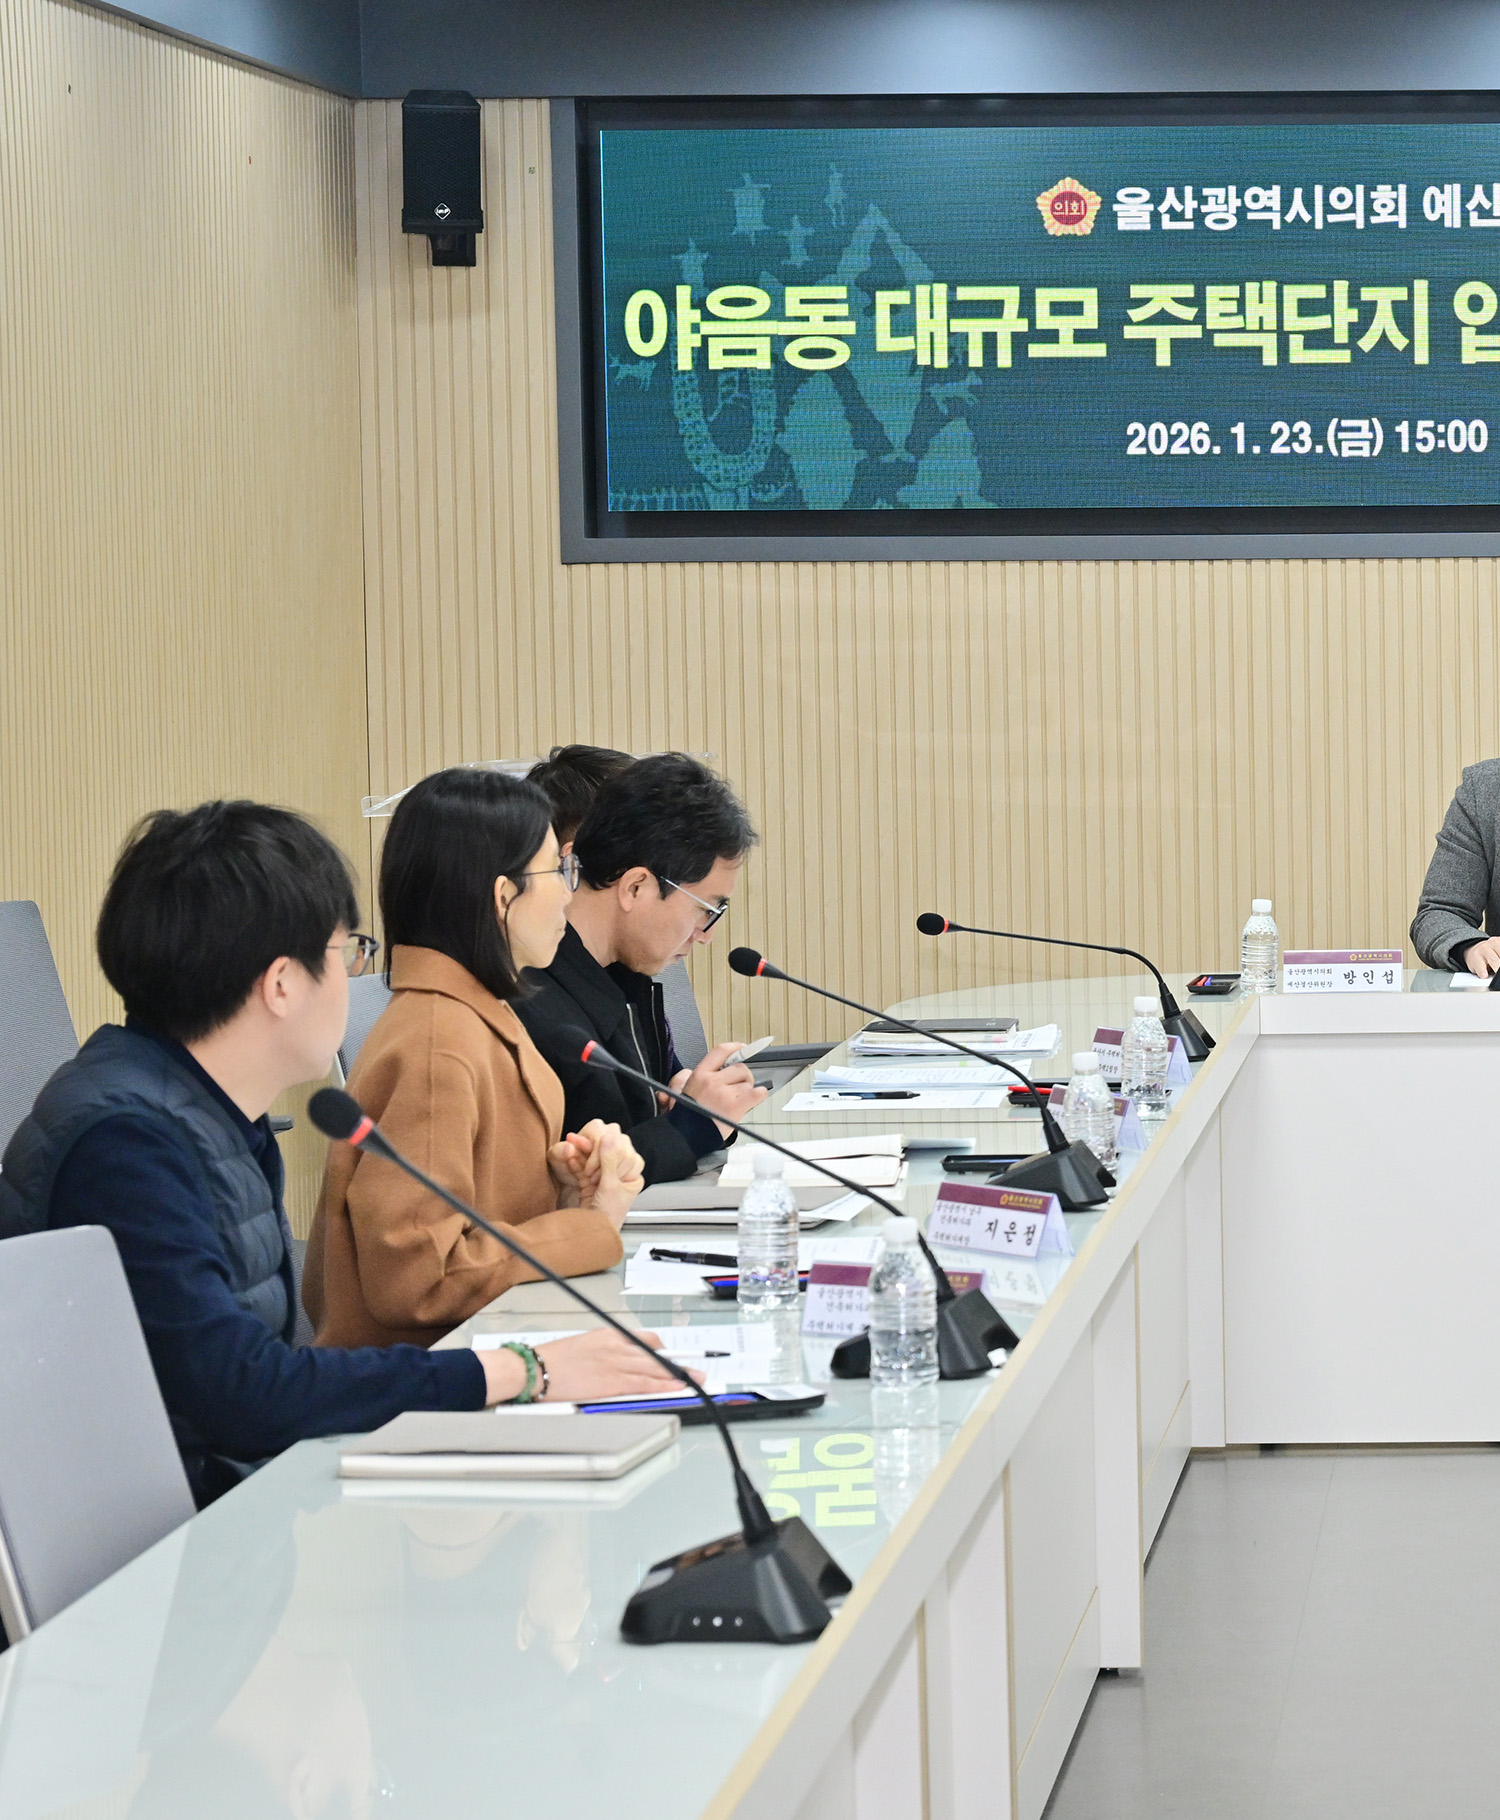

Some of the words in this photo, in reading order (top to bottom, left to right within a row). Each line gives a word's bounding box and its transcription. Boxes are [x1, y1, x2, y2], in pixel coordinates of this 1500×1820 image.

[1053, 200, 1085, 215] 의회
[1113, 183, 1407, 230] 울산광역시의회
[624, 284, 856, 371] 야음동
[875, 283, 1107, 369] 대규모
[1123, 280, 1429, 366] 주택단지
[1126, 421, 1221, 455] 2026.
[1230, 421, 1261, 454] 1.
[1270, 417, 1384, 458] 23.(금)
[1395, 418, 1489, 453] 15:00
[1343, 969, 1394, 985] 방인섭
[985, 1219, 1037, 1247] 지은정
